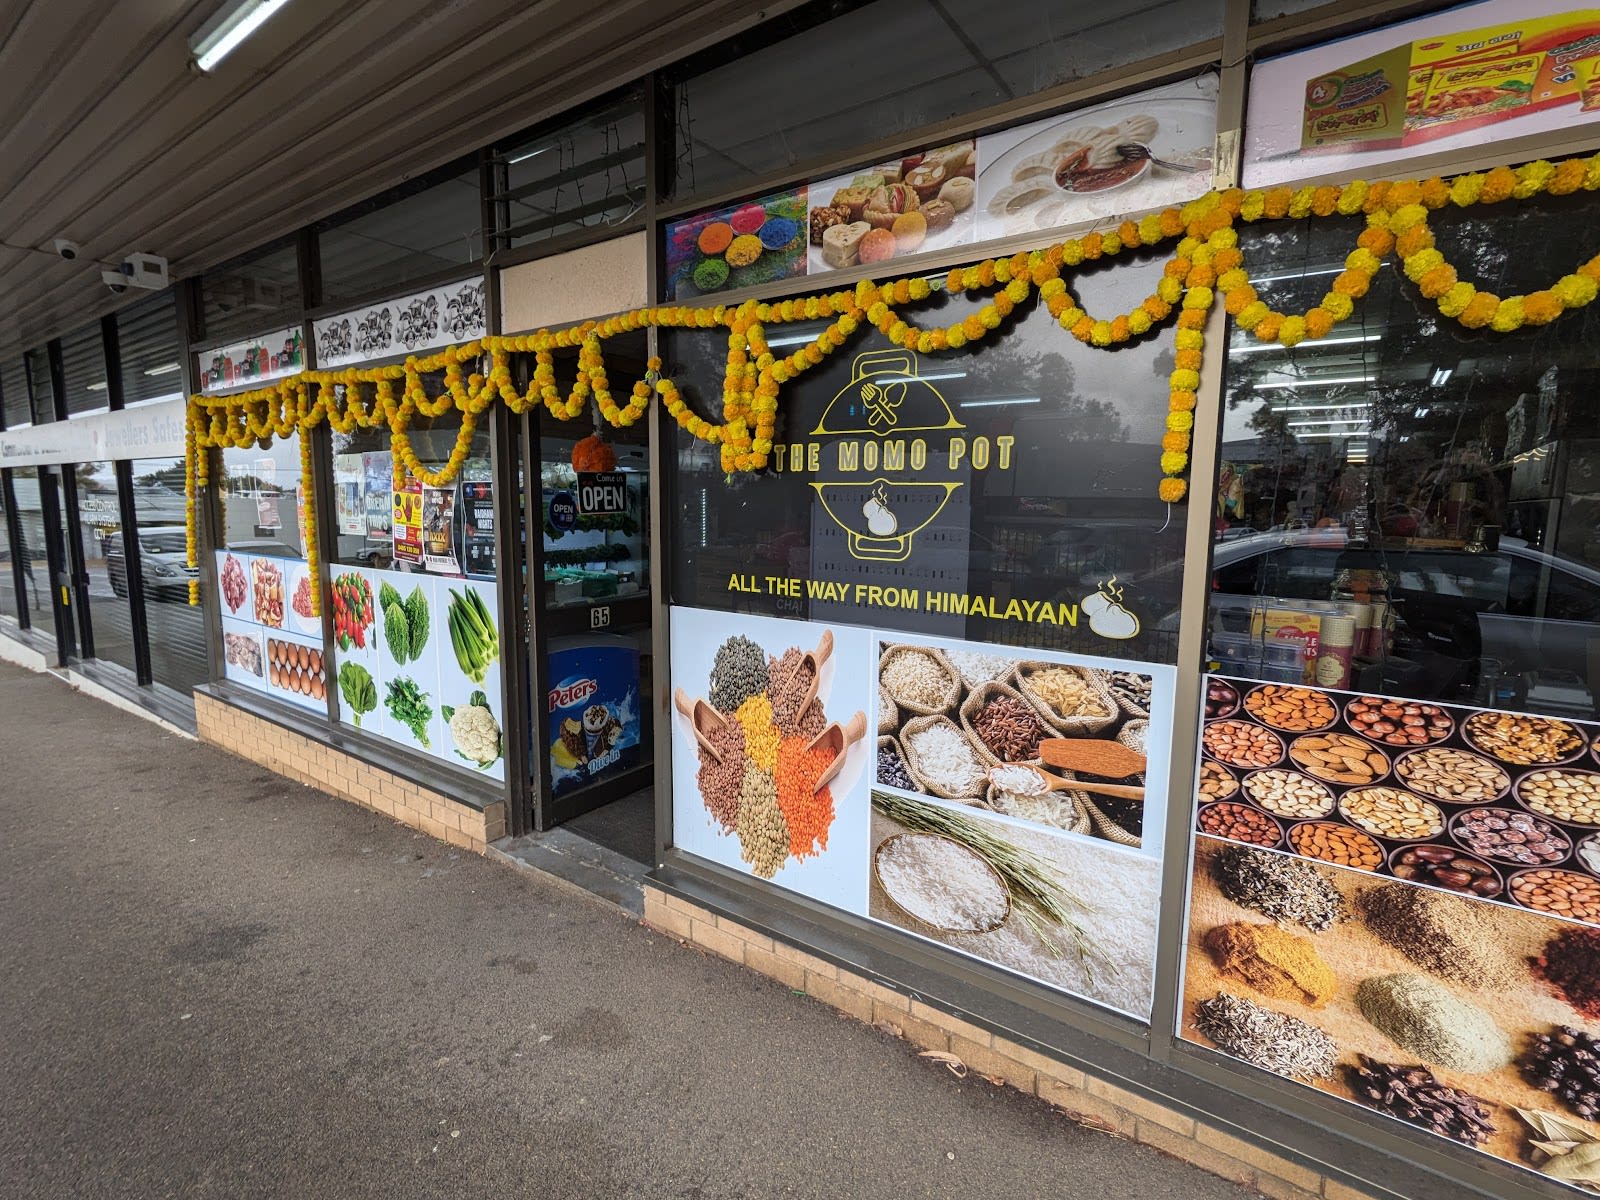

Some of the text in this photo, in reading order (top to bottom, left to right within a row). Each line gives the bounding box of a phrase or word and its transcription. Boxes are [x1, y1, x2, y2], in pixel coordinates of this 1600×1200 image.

[774, 435, 1015, 472] THE MOMO POT
[596, 473, 615, 482] Come
[553, 503, 574, 514] OPEN
[582, 486, 624, 511] OPEN
[728, 573, 1078, 627] ALL THE WAY FROM HIMALAYAN
[592, 607, 610, 627] 65
[548, 679, 598, 713] Peters
[588, 755, 611, 775] Dive
